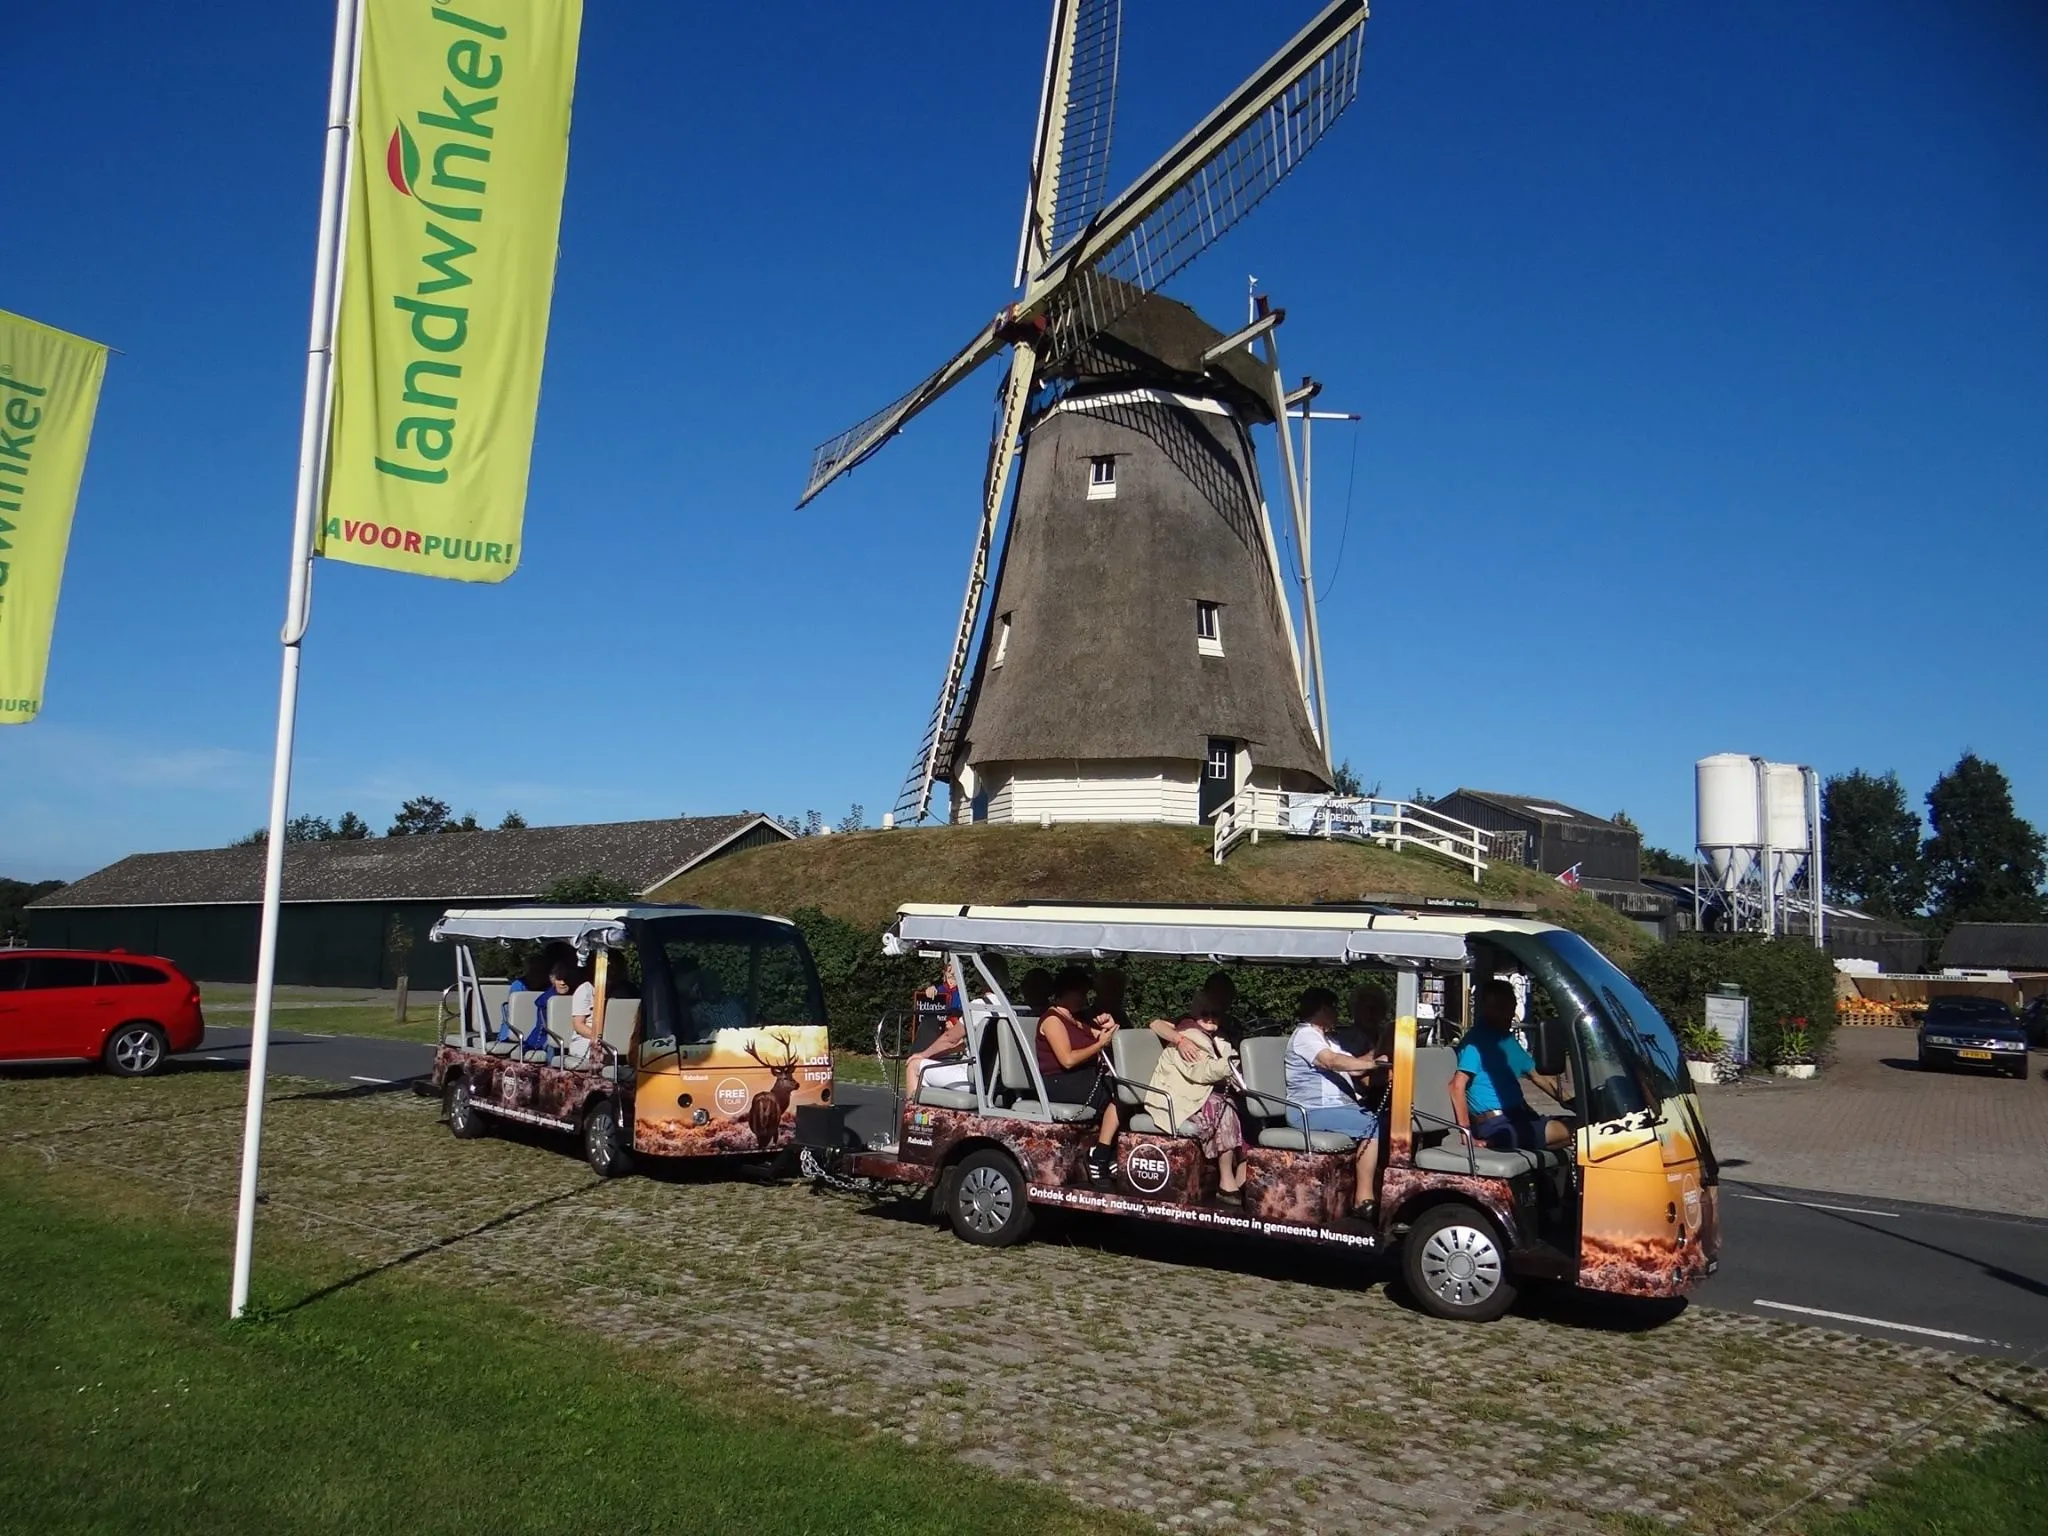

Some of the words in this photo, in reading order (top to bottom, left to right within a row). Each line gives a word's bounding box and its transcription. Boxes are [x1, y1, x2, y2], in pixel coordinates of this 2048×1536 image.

[374, 7, 508, 485] landwinkel
[804, 1054, 830, 1066] Laat
[718, 1088, 745, 1099] FREE
[724, 1098, 742, 1106] TOUR
[1132, 1157, 1166, 1172] FREE
[1137, 1171, 1160, 1181] TOUR
[1029, 1186, 1065, 1201] Ontdek
[1065, 1192, 1078, 1203] de
[1079, 1194, 1110, 1209] kunst,
[1110, 1200, 1146, 1213] natuur,
[1146, 1204, 1197, 1221] waterpret
[1199, 1213, 1212, 1222] en
[1213, 1213, 1250, 1228] horeca
[1251, 1218, 1262, 1230] in
[1264, 1222, 1319, 1239] gemeente
[1320, 1228, 1376, 1247] Nunspeet
